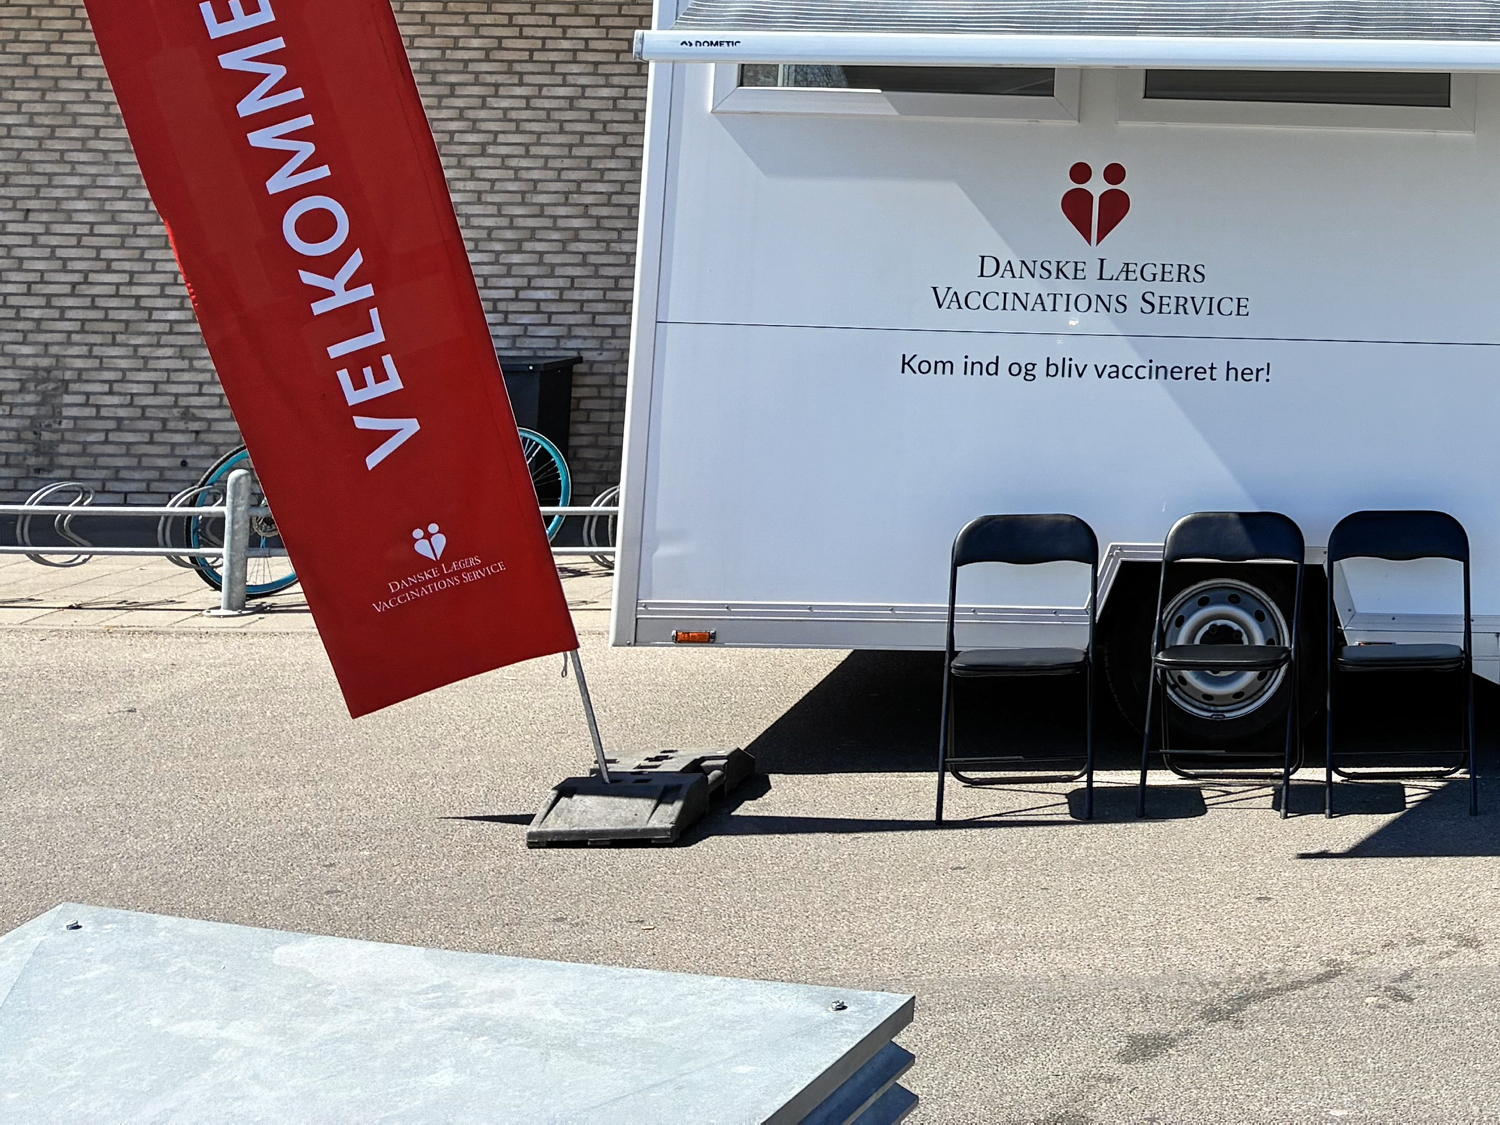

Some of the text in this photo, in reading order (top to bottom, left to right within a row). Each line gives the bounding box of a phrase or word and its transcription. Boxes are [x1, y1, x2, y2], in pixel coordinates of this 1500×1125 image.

[977, 254, 1206, 284] DANSKE LÆGERS
[930, 285, 1250, 317] VACCINATIONS SERVICE
[901, 353, 1272, 383] Kom ind og bliv vaccineret her!
[372, 561, 506, 613] VACCINATIONS SERVICE
[388, 555, 482, 593] DANSKE LÆGERS
